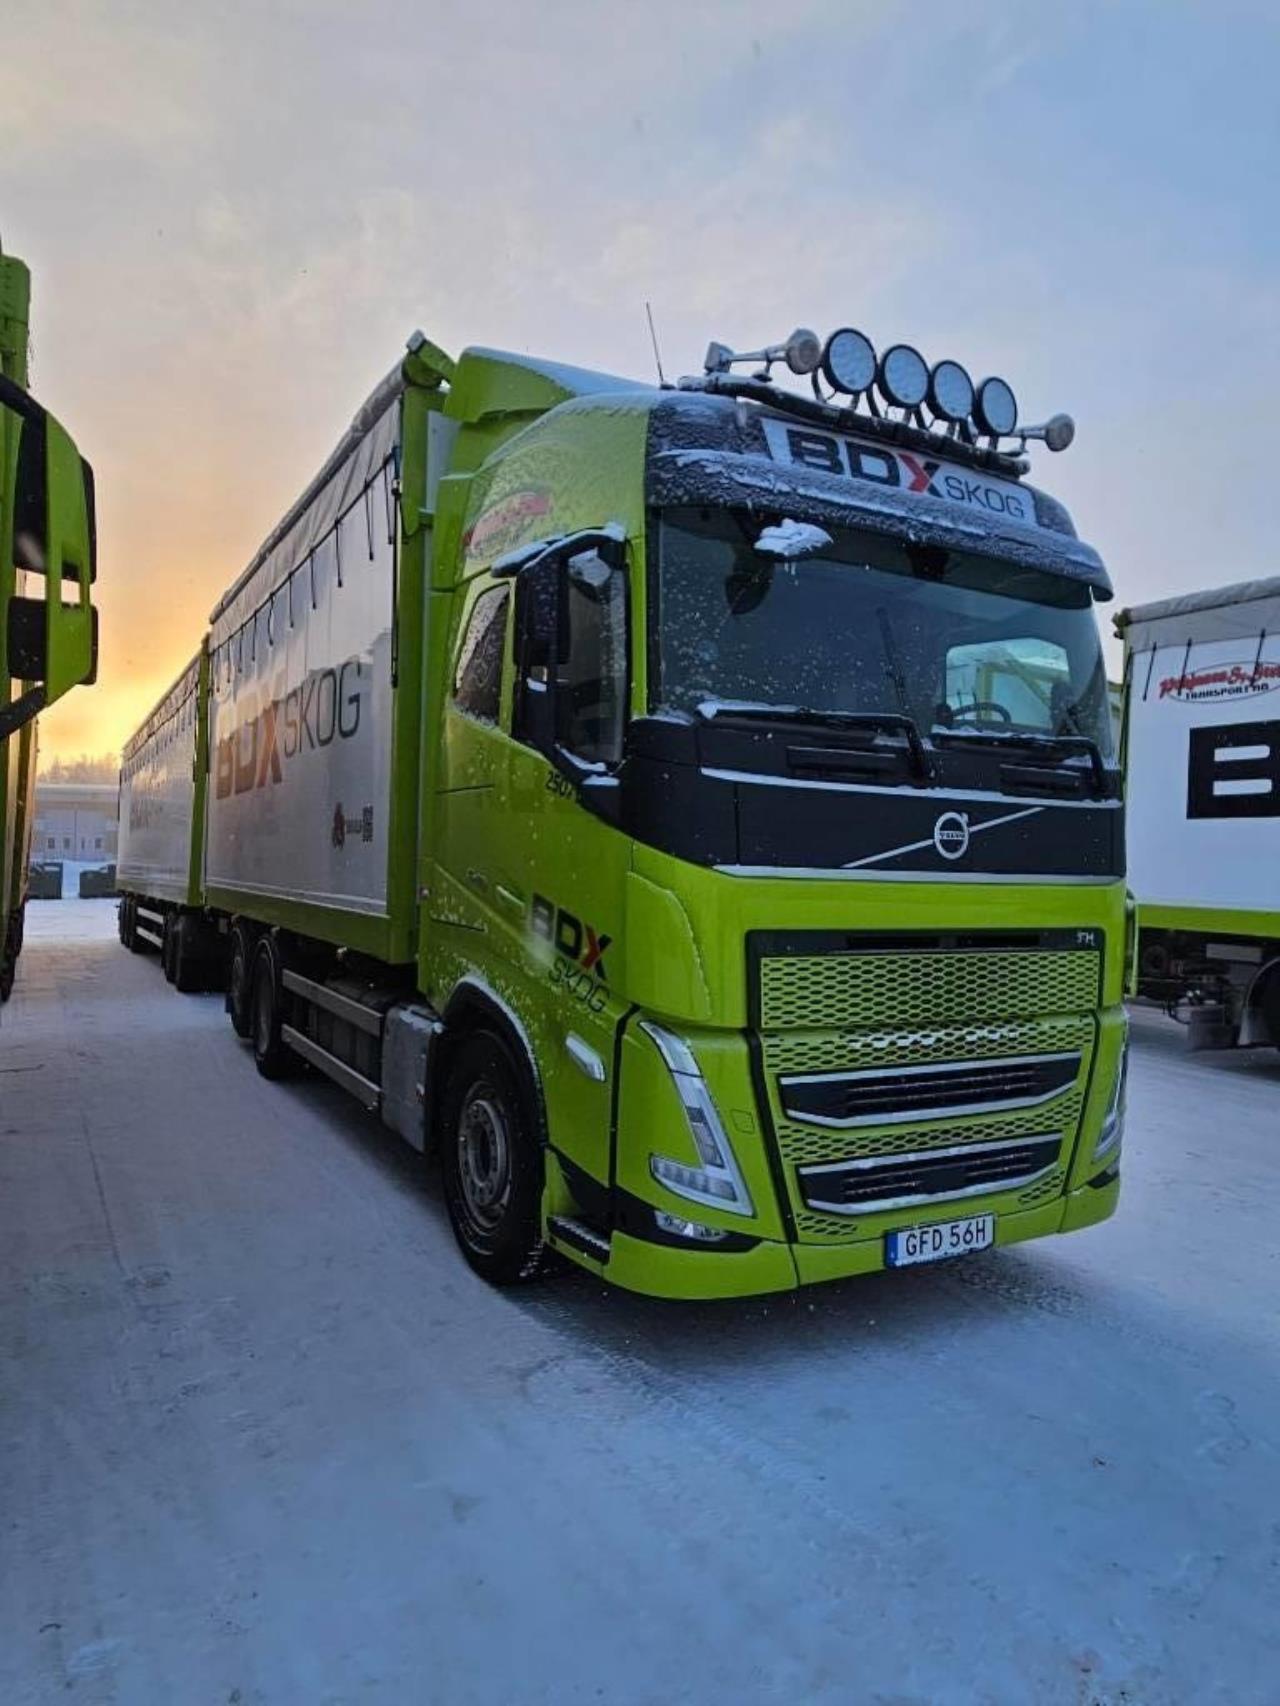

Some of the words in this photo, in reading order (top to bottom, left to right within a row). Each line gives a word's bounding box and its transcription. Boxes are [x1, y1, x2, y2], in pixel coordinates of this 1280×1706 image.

[786, 429, 943, 498] BDX
[944, 476, 1025, 518] SKOG
[284, 658, 361, 759] SKOG
[532, 891, 612, 981] BDX
[548, 957, 611, 1012] SKOG
[906, 1229, 942, 1256] GFD
[949, 1218, 986, 1248] 56H
